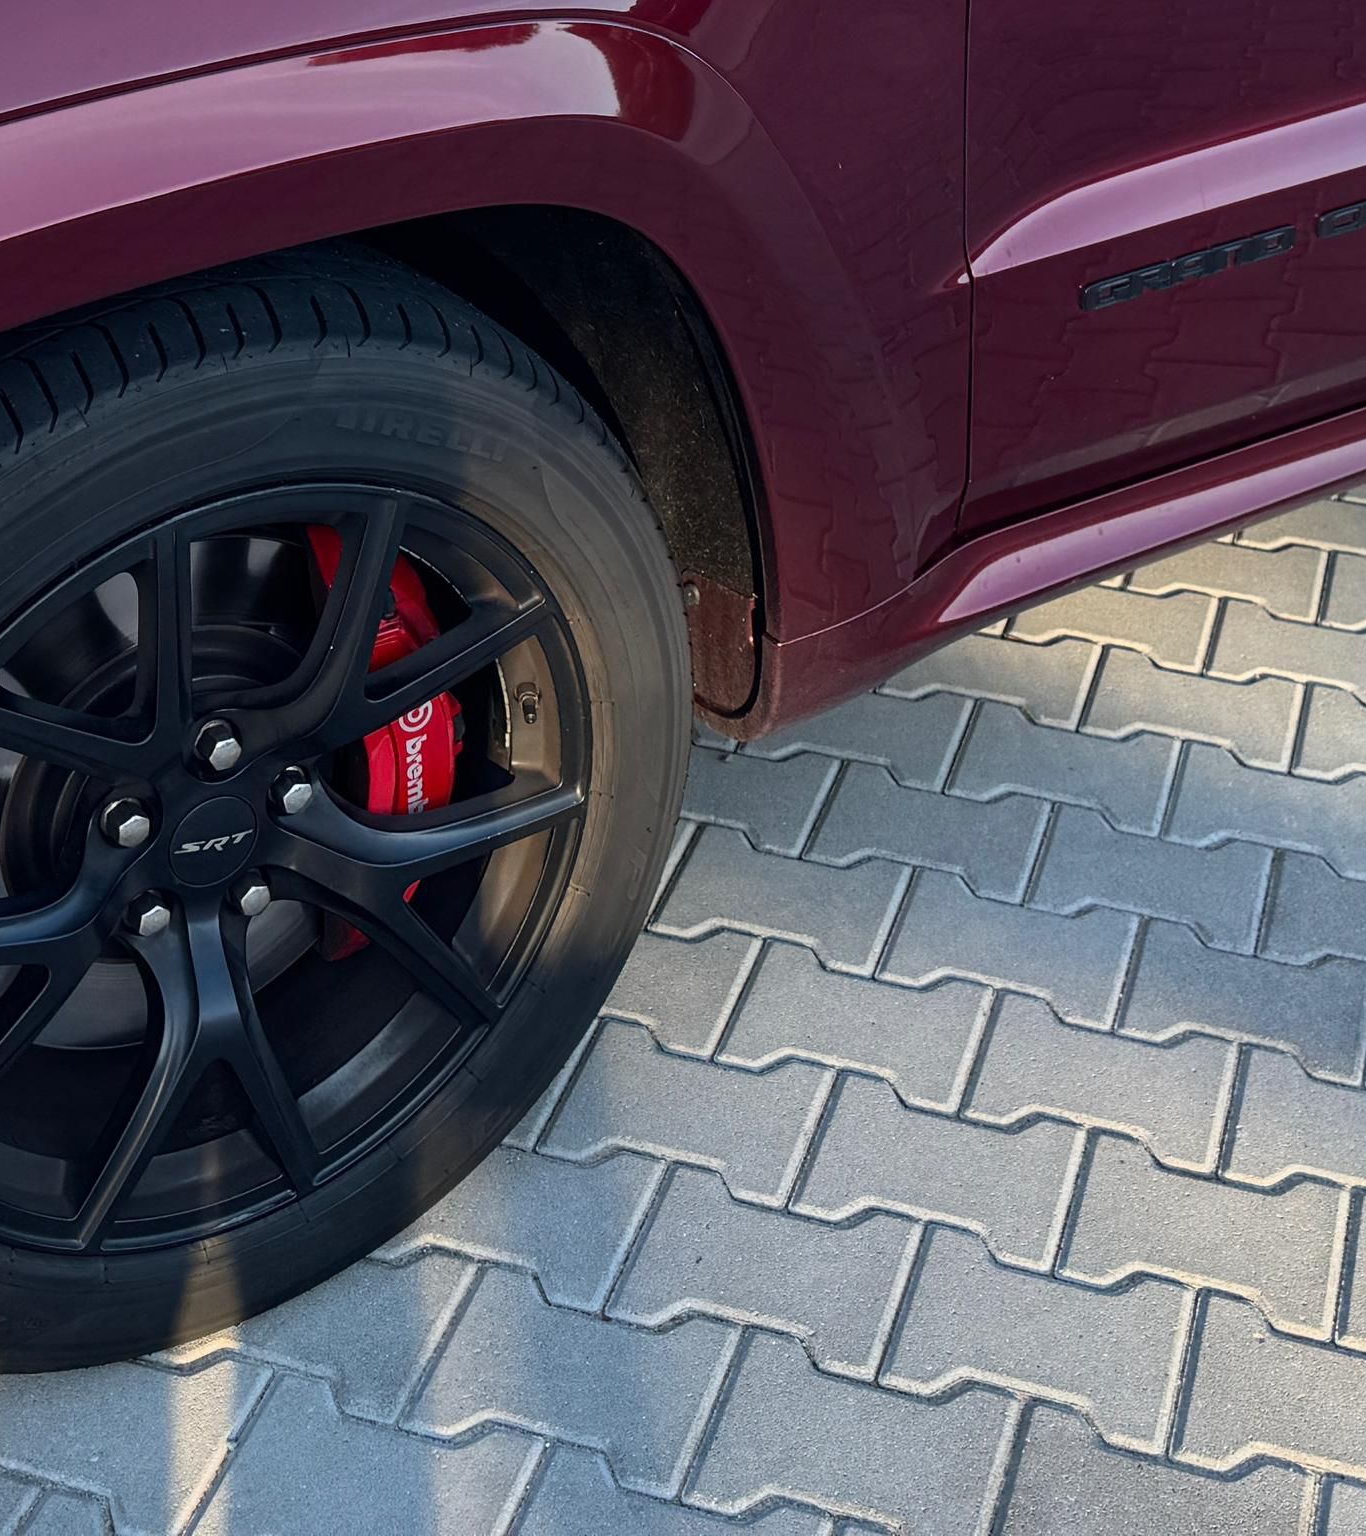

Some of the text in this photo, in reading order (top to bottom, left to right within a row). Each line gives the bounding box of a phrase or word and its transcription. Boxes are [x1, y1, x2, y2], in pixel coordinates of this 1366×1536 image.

[1079, 225, 1296, 312] GRAND
[404, 733, 429, 815] bremb
[173, 828, 254, 855] SRT
